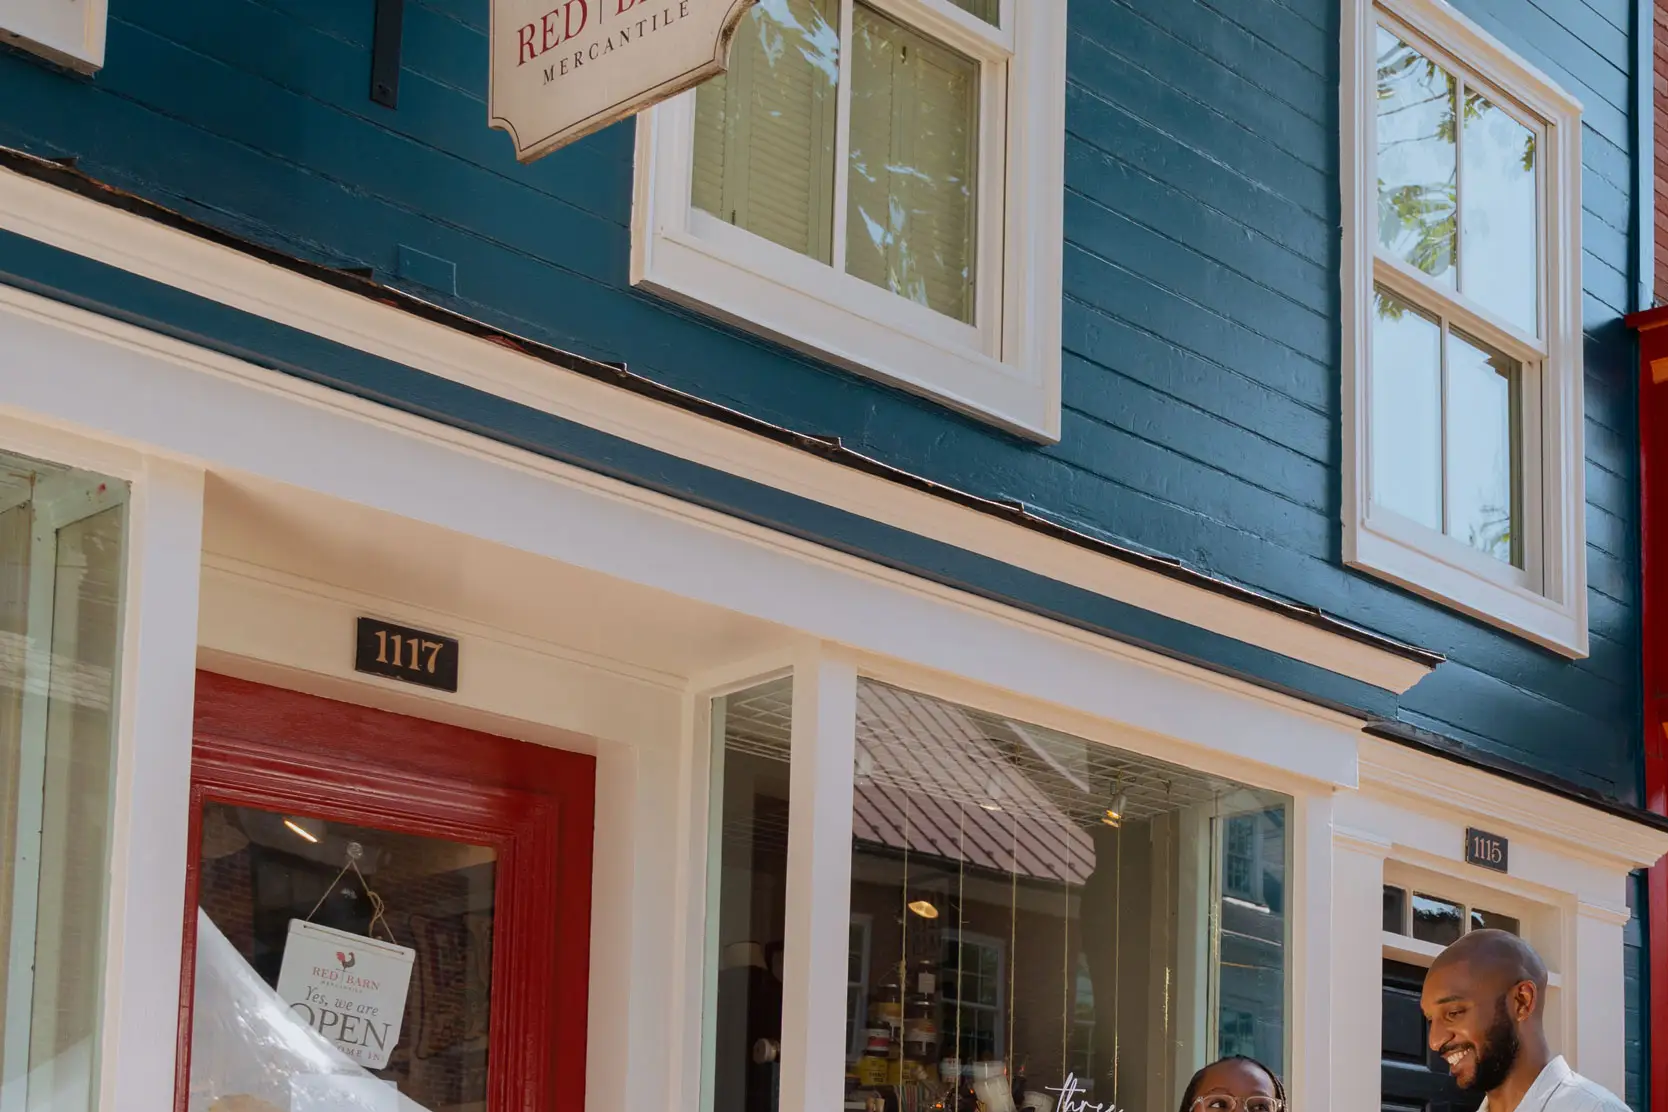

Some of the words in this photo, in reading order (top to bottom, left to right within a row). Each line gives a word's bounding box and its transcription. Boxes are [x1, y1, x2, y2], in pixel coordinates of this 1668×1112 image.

[517, 0, 588, 68] RED
[543, 0, 690, 86] MERCANTILE
[374, 630, 444, 674] 1117
[1473, 836, 1503, 864] 1115
[312, 966, 339, 981] RED
[346, 974, 381, 991] BARN
[305, 985, 329, 1007] Yes,
[335, 998, 354, 1011] we
[356, 1005, 379, 1017] are
[289, 1002, 392, 1052] OPEN
